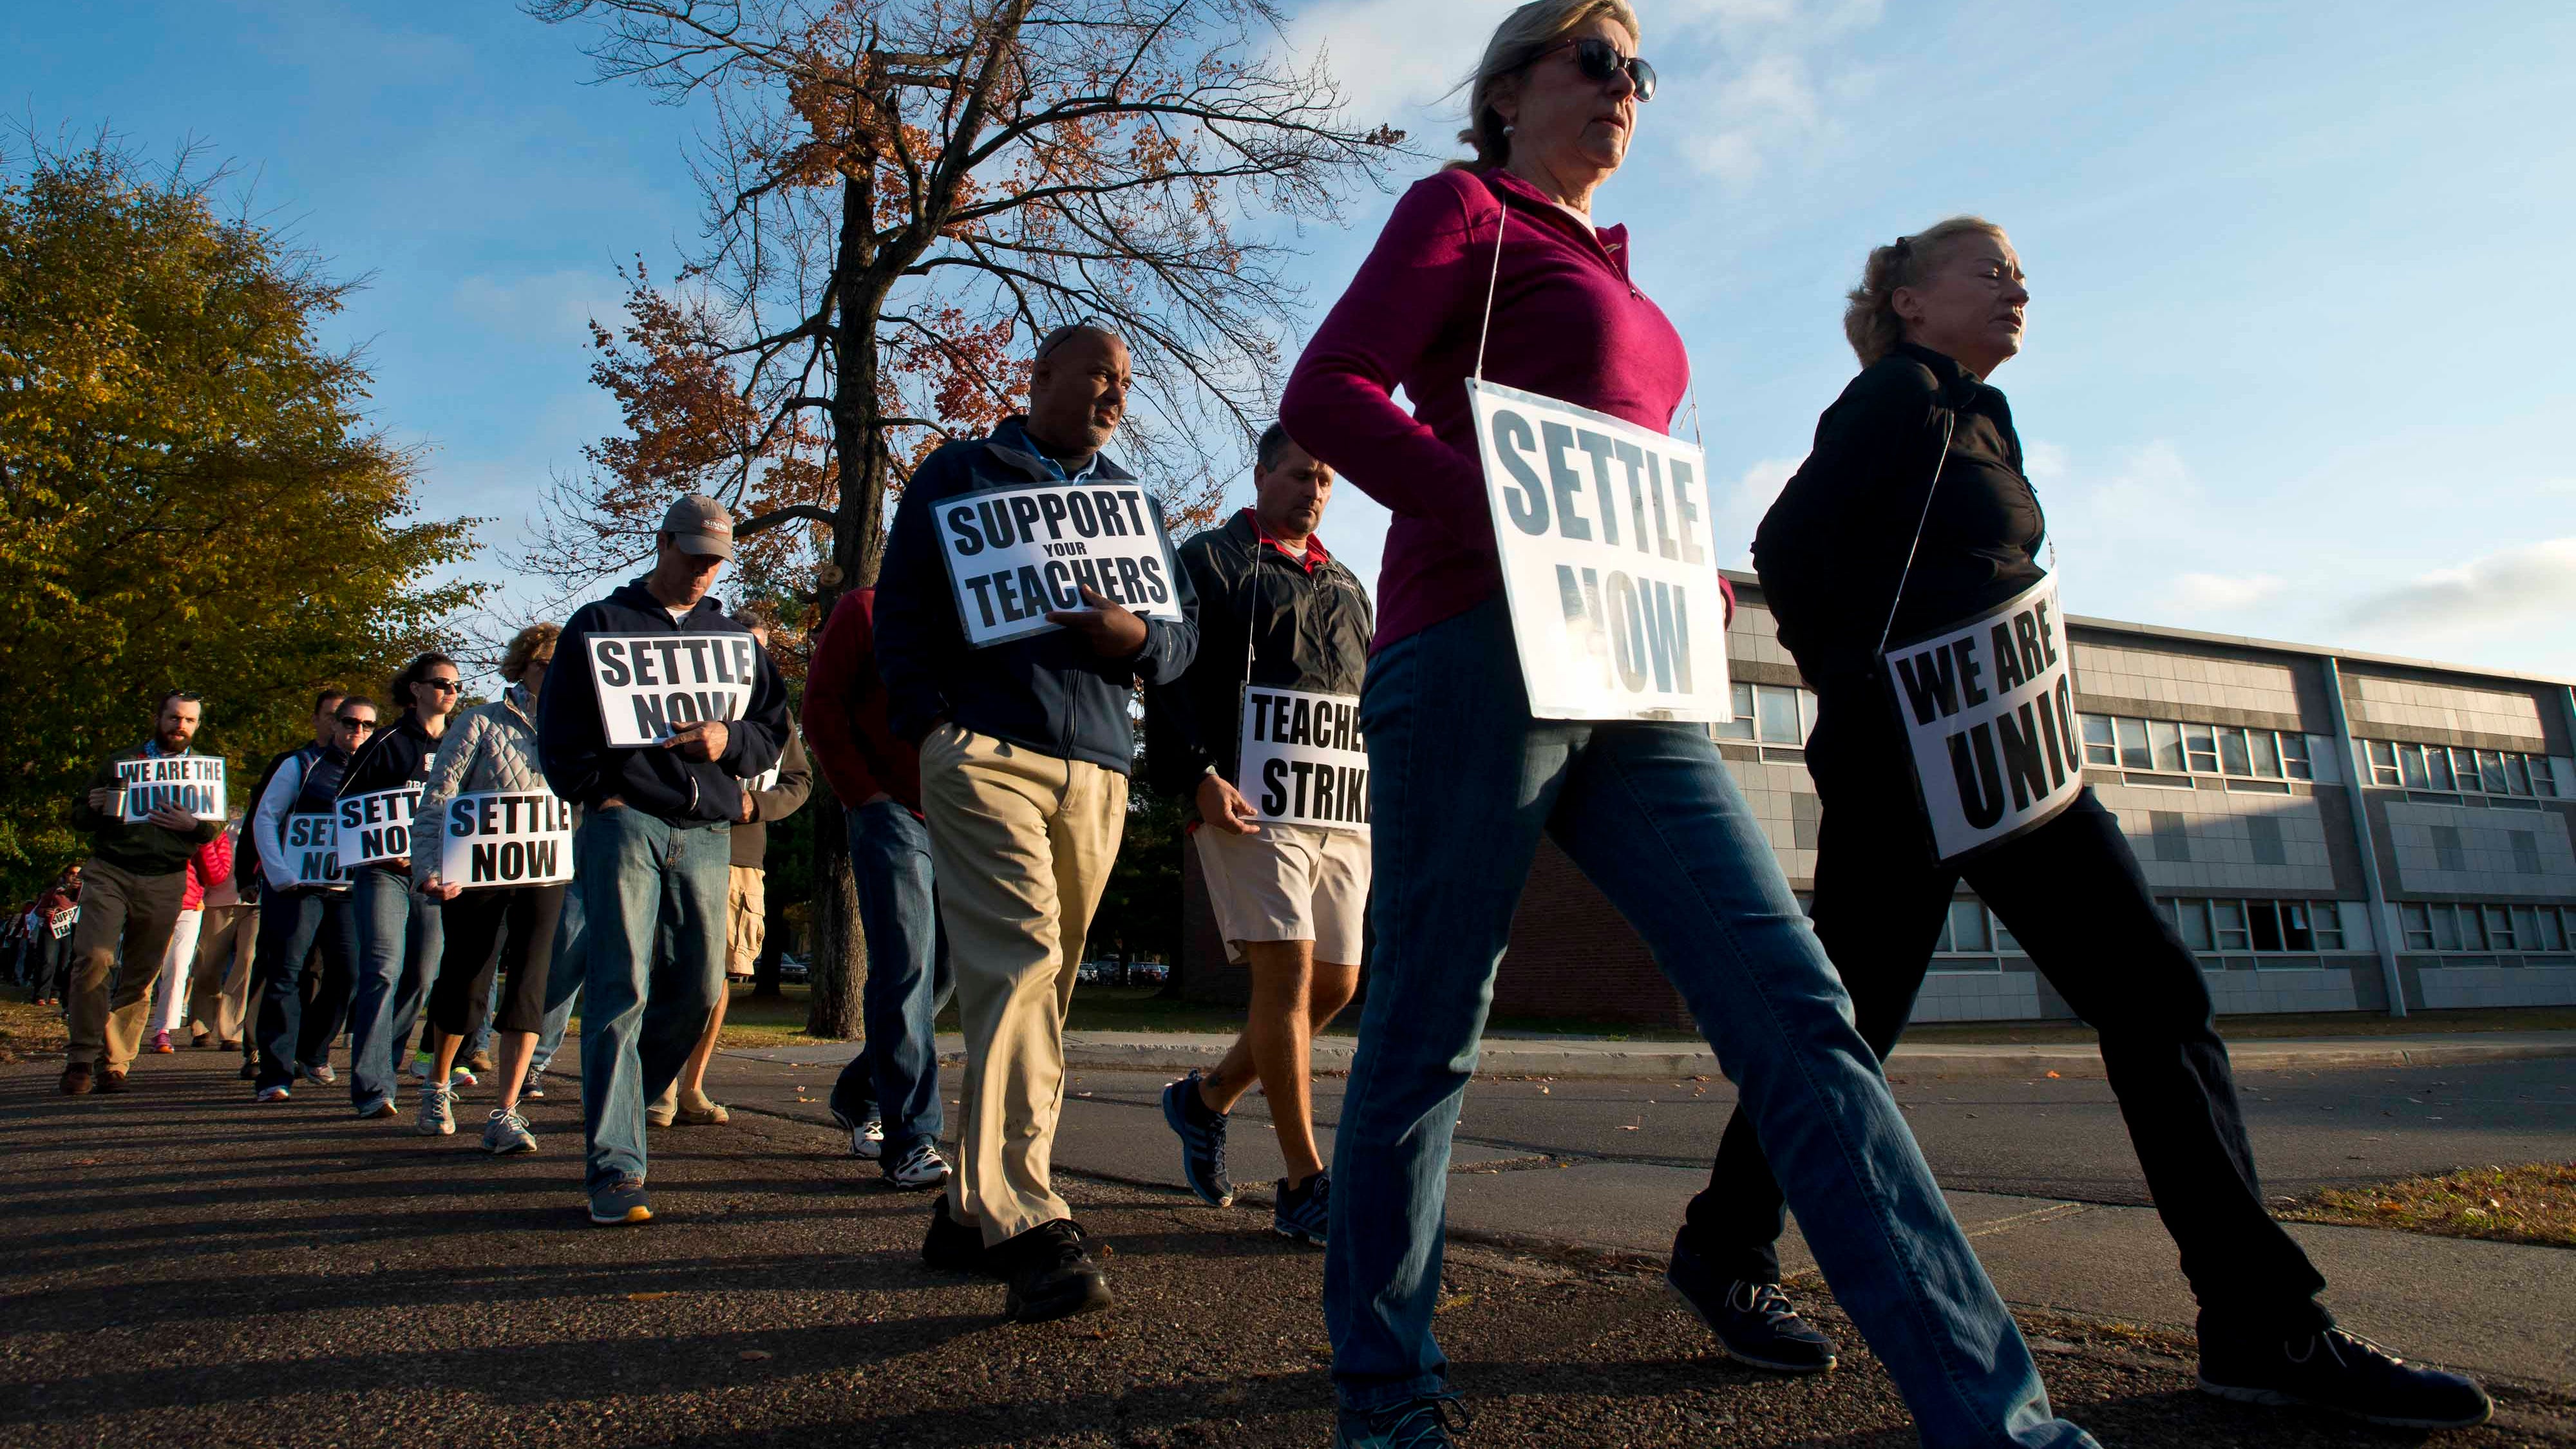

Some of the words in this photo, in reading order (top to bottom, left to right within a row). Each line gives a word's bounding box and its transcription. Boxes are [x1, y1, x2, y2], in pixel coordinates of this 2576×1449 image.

[1492, 409, 1705, 566] SETTLE
[947, 491, 1146, 556] SUPPORT
[1042, 542, 1088, 558] YOUR
[965, 556, 1168, 629] TEACHERS
[596, 639, 752, 687] SETTLE
[1895, 636, 1989, 727] WE
[1991, 598, 2058, 696] ARE
[632, 692, 737, 739] NOW
[1251, 693, 1368, 753] TEACHE
[121, 762, 151, 783] WE
[156, 761, 190, 781] ARE
[194, 761, 222, 781] THE
[1946, 674, 2080, 830] UNIO
[131, 784, 215, 817] UNION
[341, 791, 421, 829] SETT
[451, 795, 569, 837] SETTLE
[361, 825, 412, 859] NO
[471, 839, 558, 882] NOW
